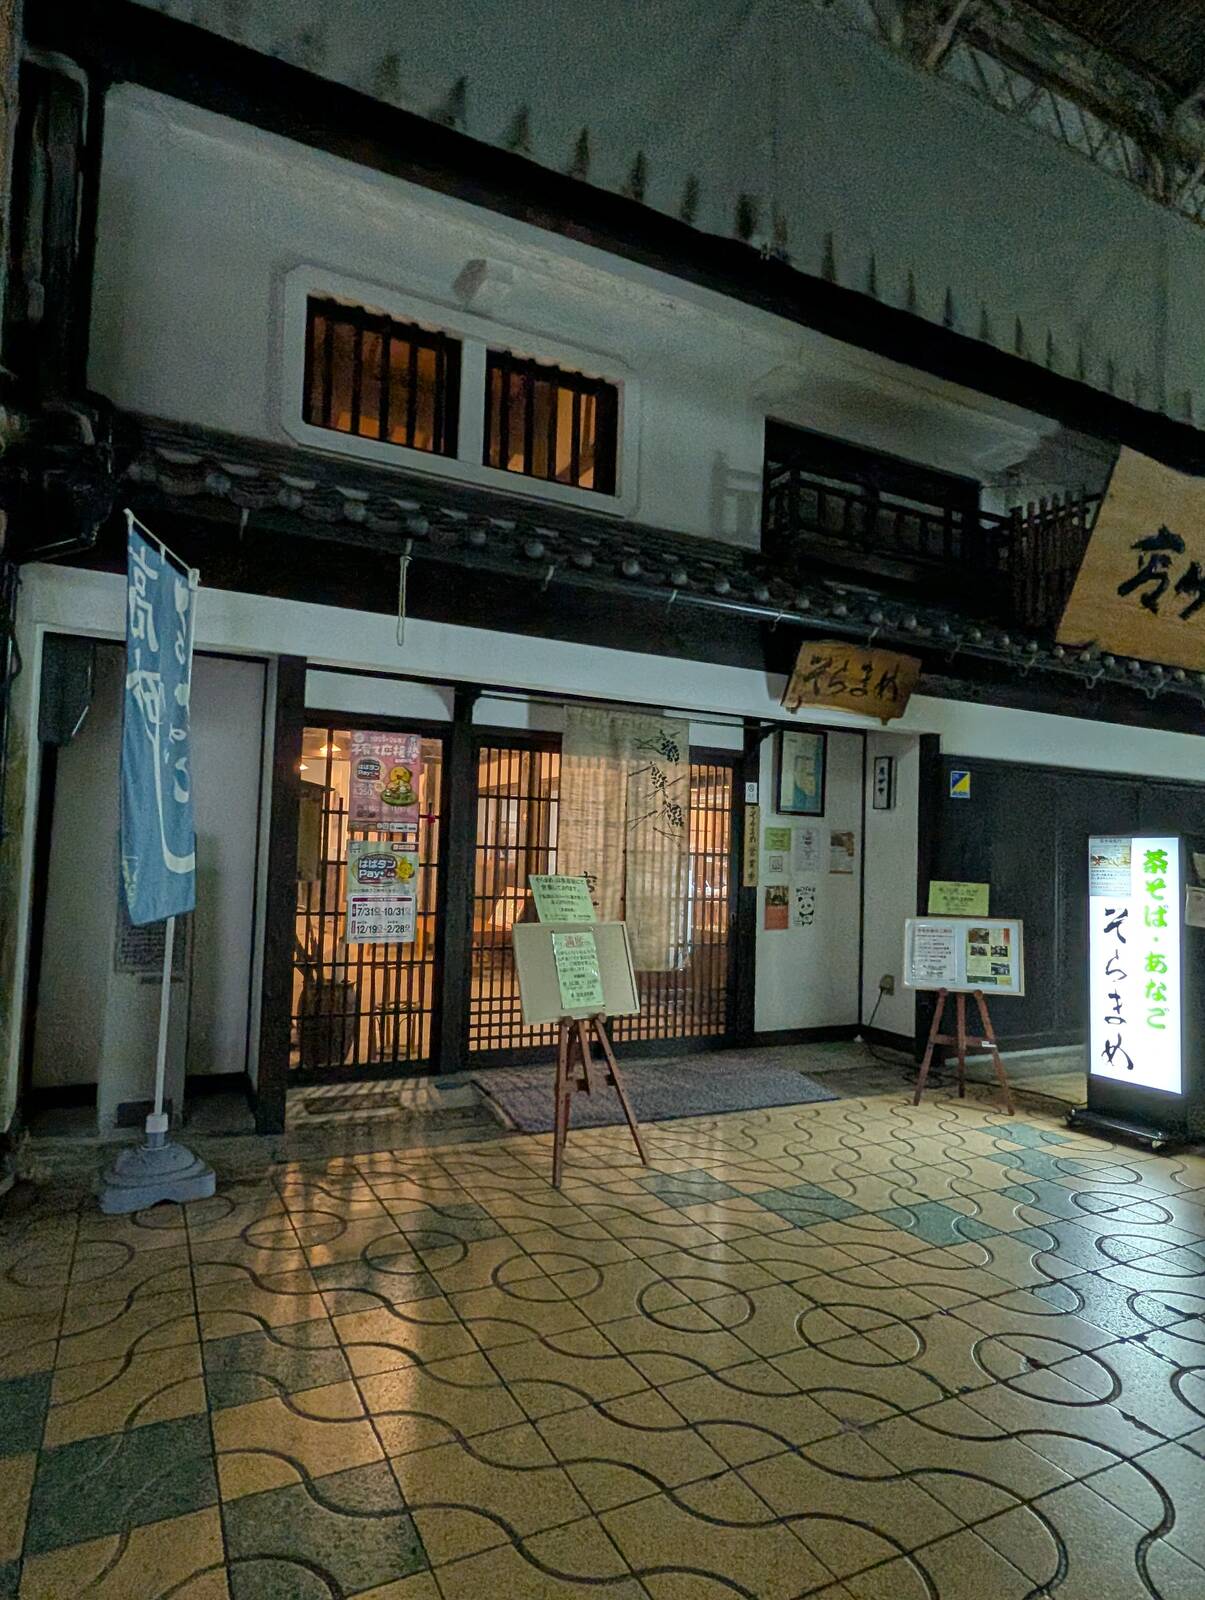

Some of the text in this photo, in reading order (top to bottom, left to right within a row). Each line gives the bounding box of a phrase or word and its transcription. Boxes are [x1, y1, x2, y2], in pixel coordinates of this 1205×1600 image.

[802, 655, 901, 702] そらまめ
[358, 859, 396, 869] はばタン
[357, 907, 405, 916] 7/31 10/31
[356, 925, 405, 934] 12/19 2/28
[1143, 848, 1170, 1030] 茶そば・あなご
[1101, 906, 1134, 1071] そらまめ
